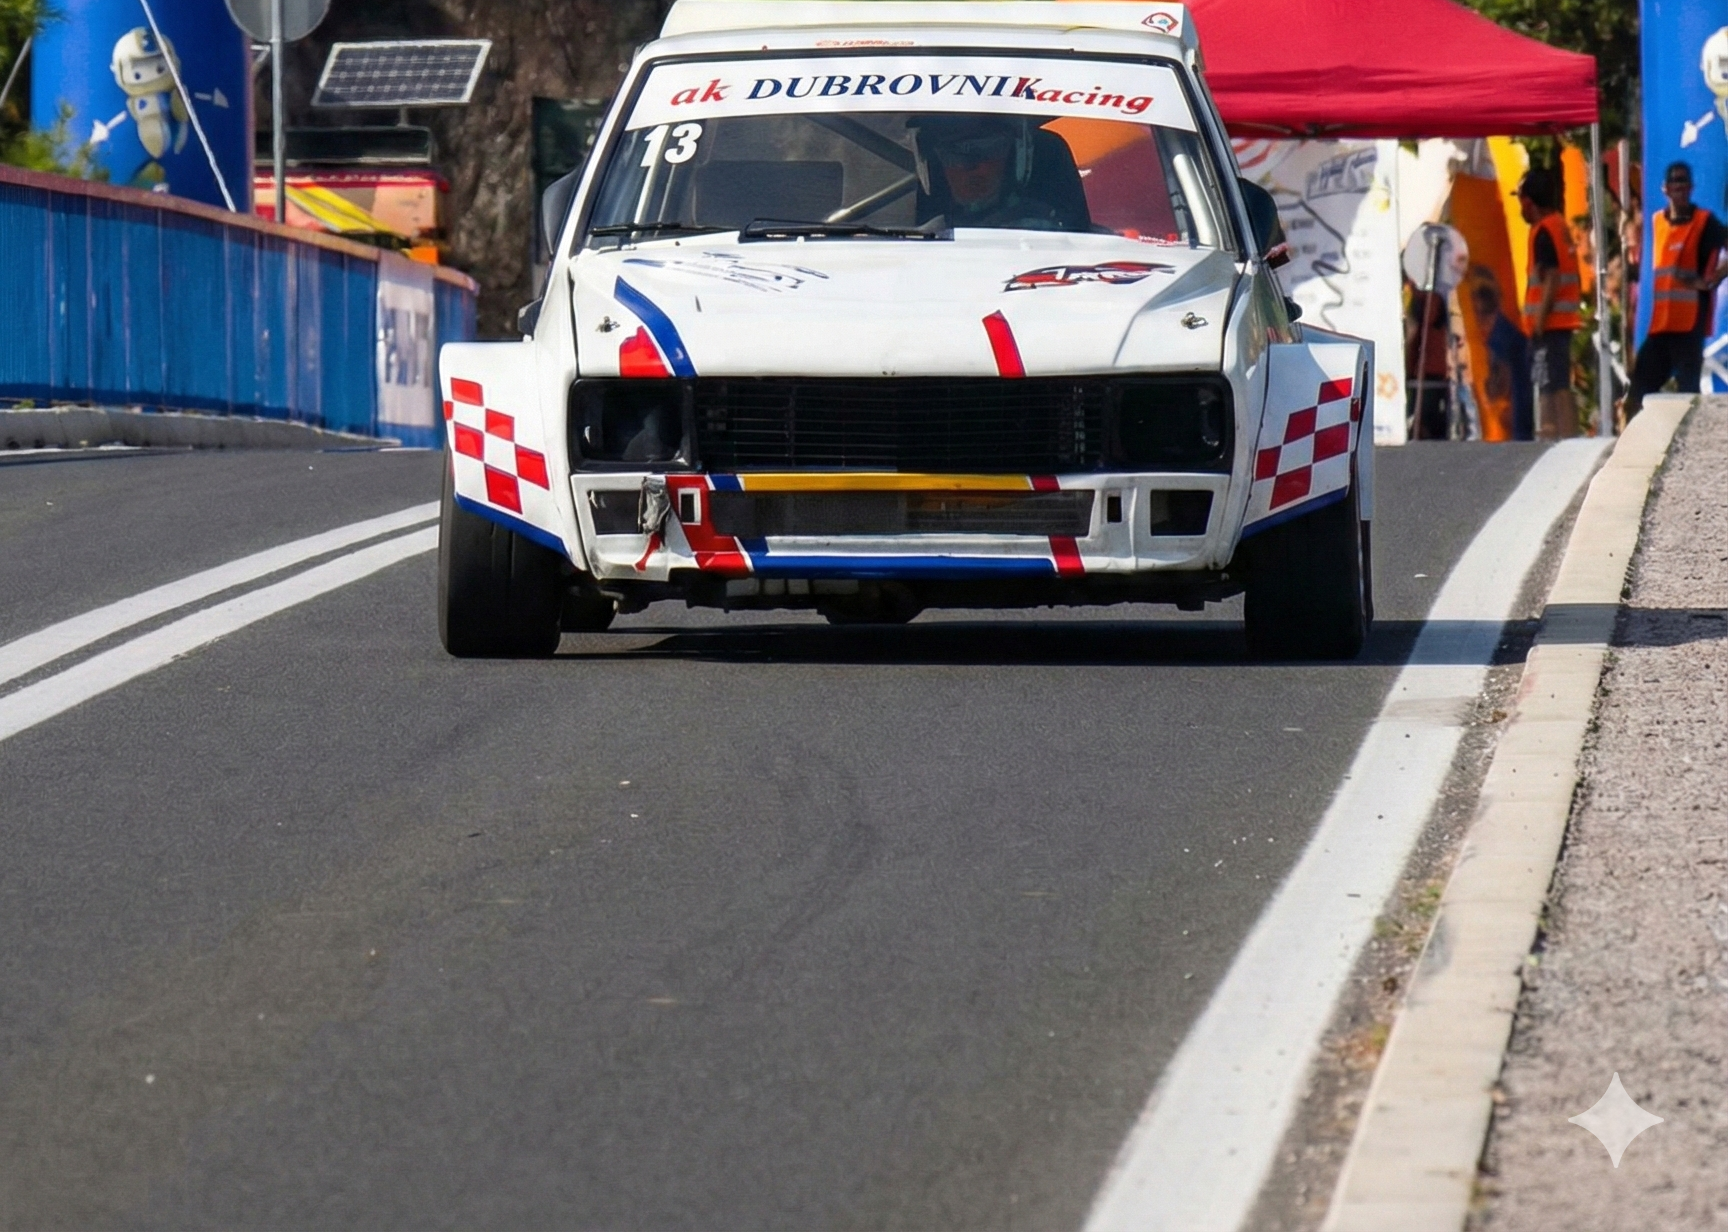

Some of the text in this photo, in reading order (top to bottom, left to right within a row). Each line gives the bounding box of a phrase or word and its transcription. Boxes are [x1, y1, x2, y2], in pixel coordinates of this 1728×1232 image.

[670, 78, 732, 106] ak
[746, 73, 1042, 100] DUBROVNIK
[640, 122, 703, 168] 13
